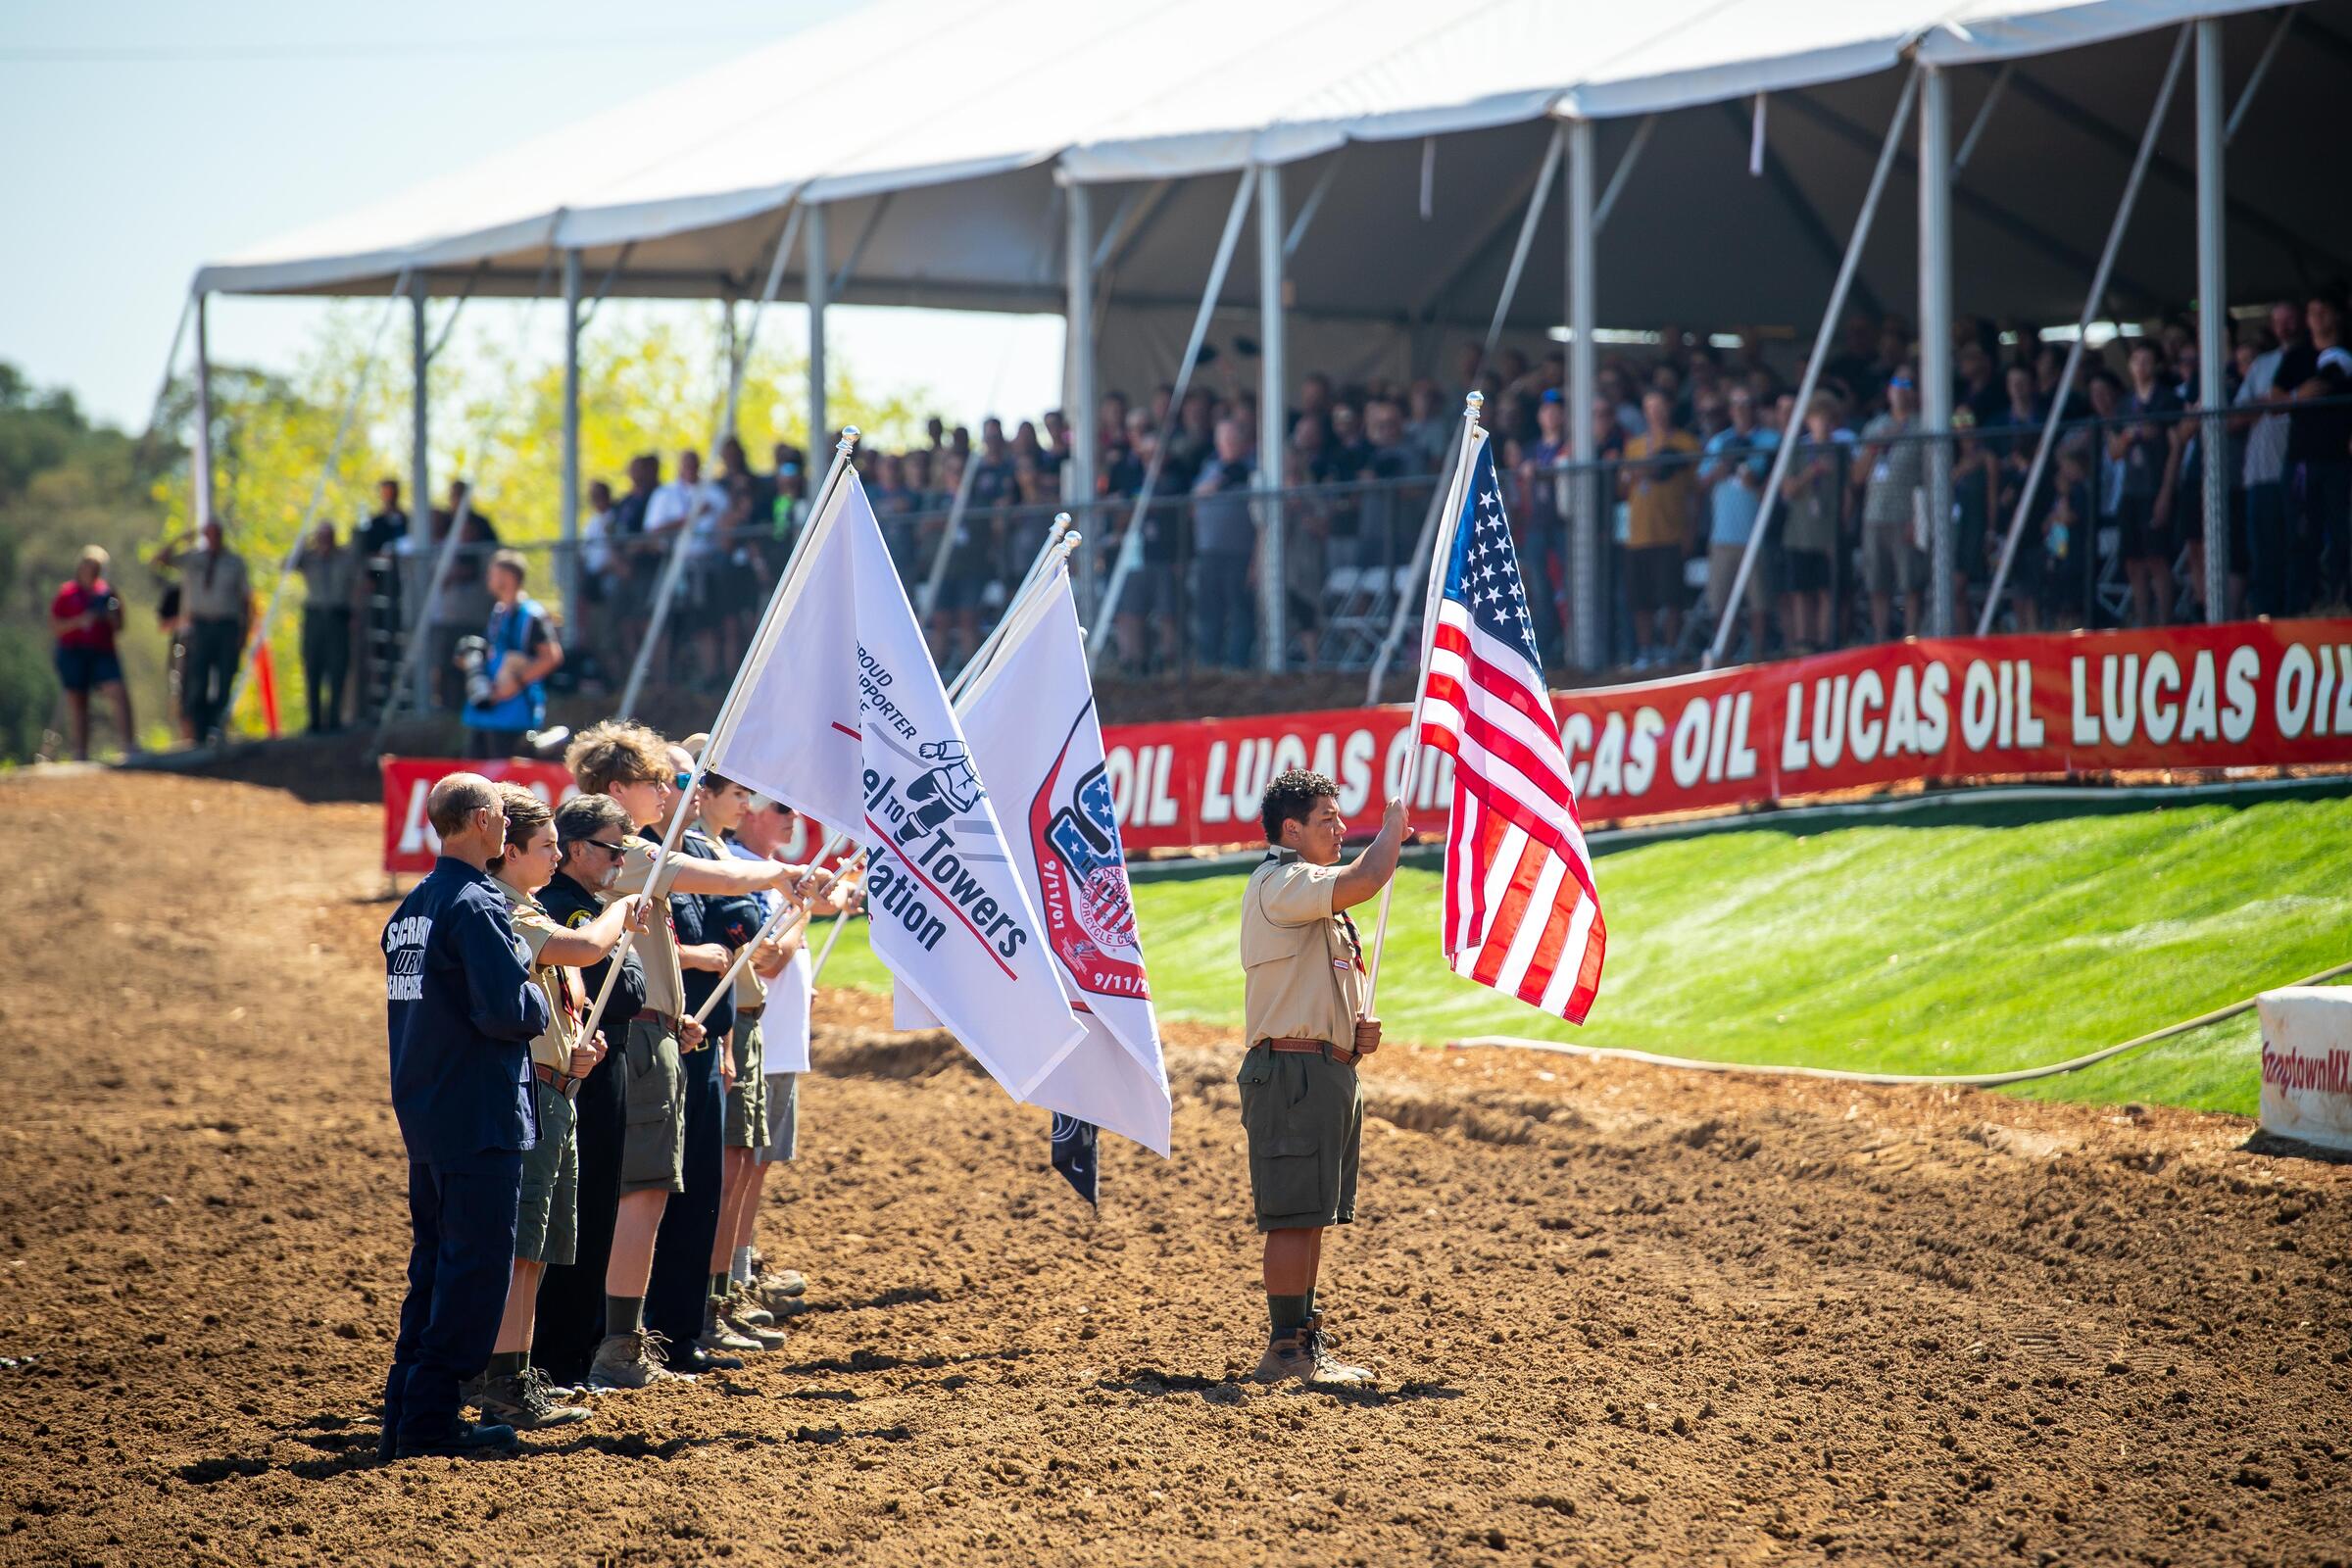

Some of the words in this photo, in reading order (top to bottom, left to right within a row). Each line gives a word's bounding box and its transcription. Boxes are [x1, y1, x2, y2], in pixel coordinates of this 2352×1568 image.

[857, 639, 893, 687] ROUD
[858, 672, 917, 740] PPORTER
[1107, 744, 1179, 828] OIL
[1670, 691, 1757, 789] OIL
[1781, 660, 1950, 771] LUCAS
[1961, 659, 2045, 753] OIL
[2071, 644, 2260, 746] LUCAS
[2275, 642, 2352, 740] OIL
[862, 767, 897, 812] el
[884, 796, 906, 823] TO
[918, 828, 1027, 958] Towers
[1044, 859, 1065, 929] 9/11/01
